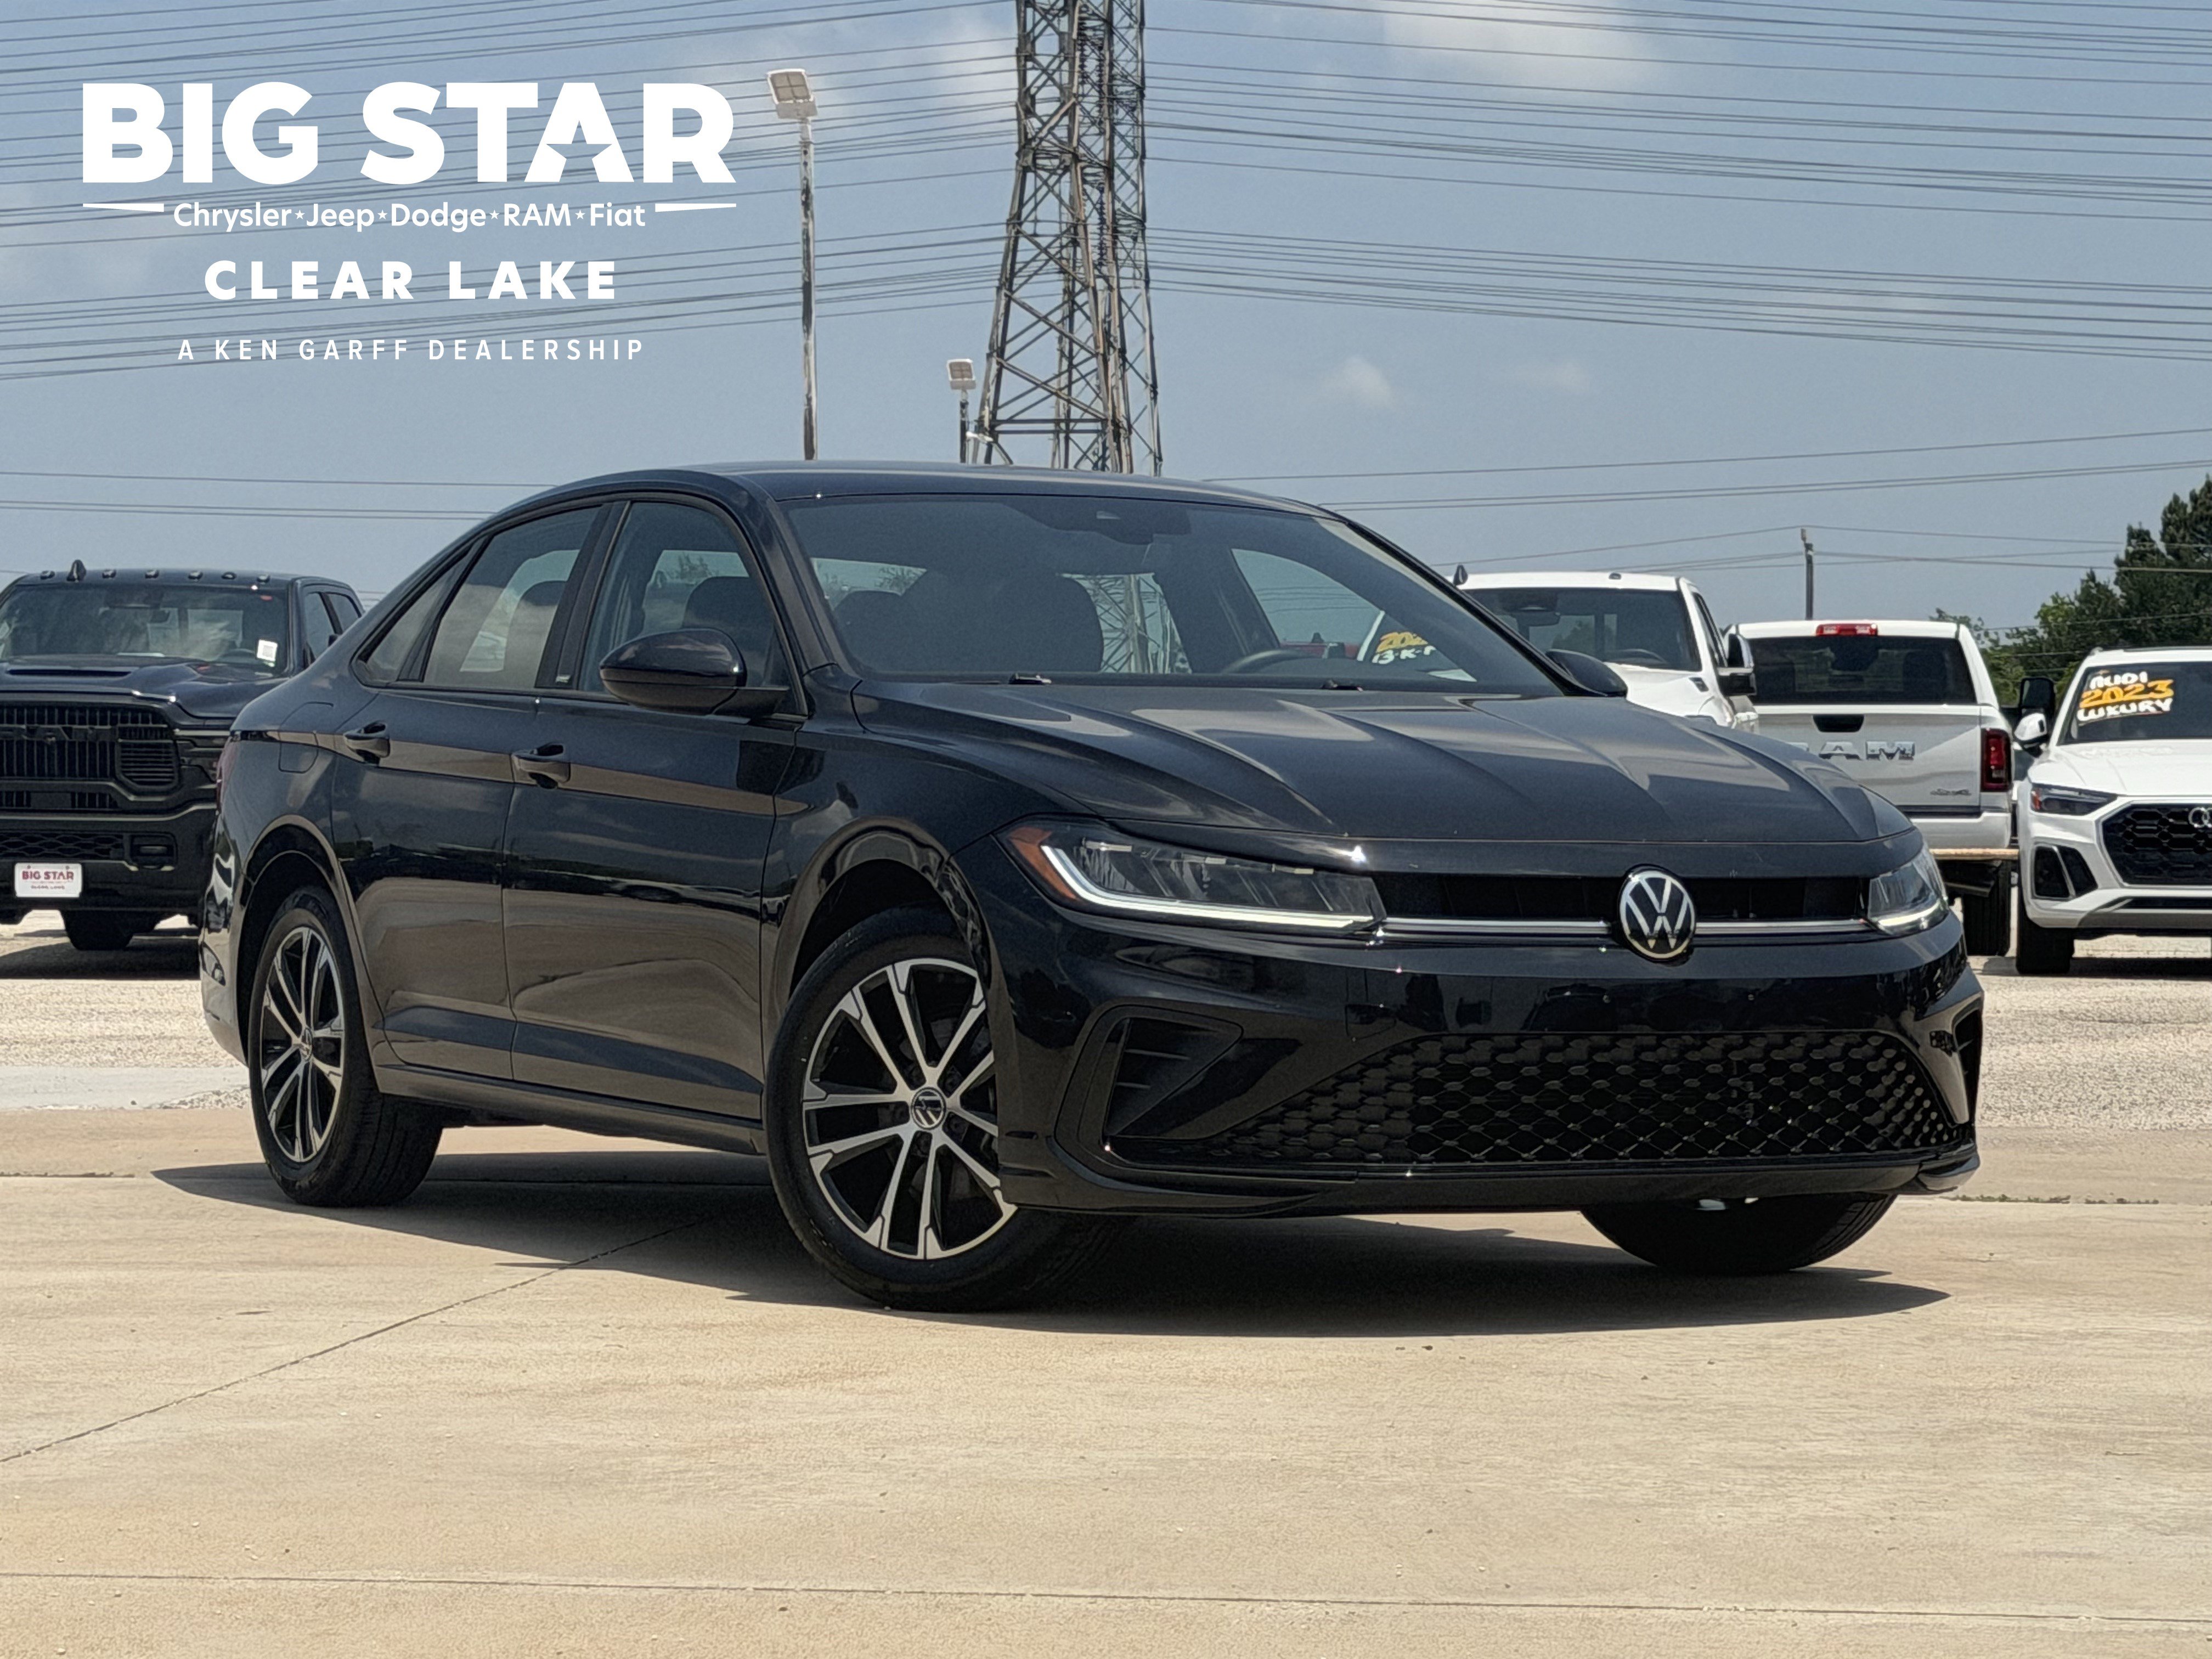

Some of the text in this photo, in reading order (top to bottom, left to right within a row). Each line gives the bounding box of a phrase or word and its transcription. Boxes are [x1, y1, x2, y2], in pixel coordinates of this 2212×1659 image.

[2079, 680, 2174, 708] 2023
[2076, 697, 2173, 721] LUXURY
[44, 871, 74, 880] STAR
